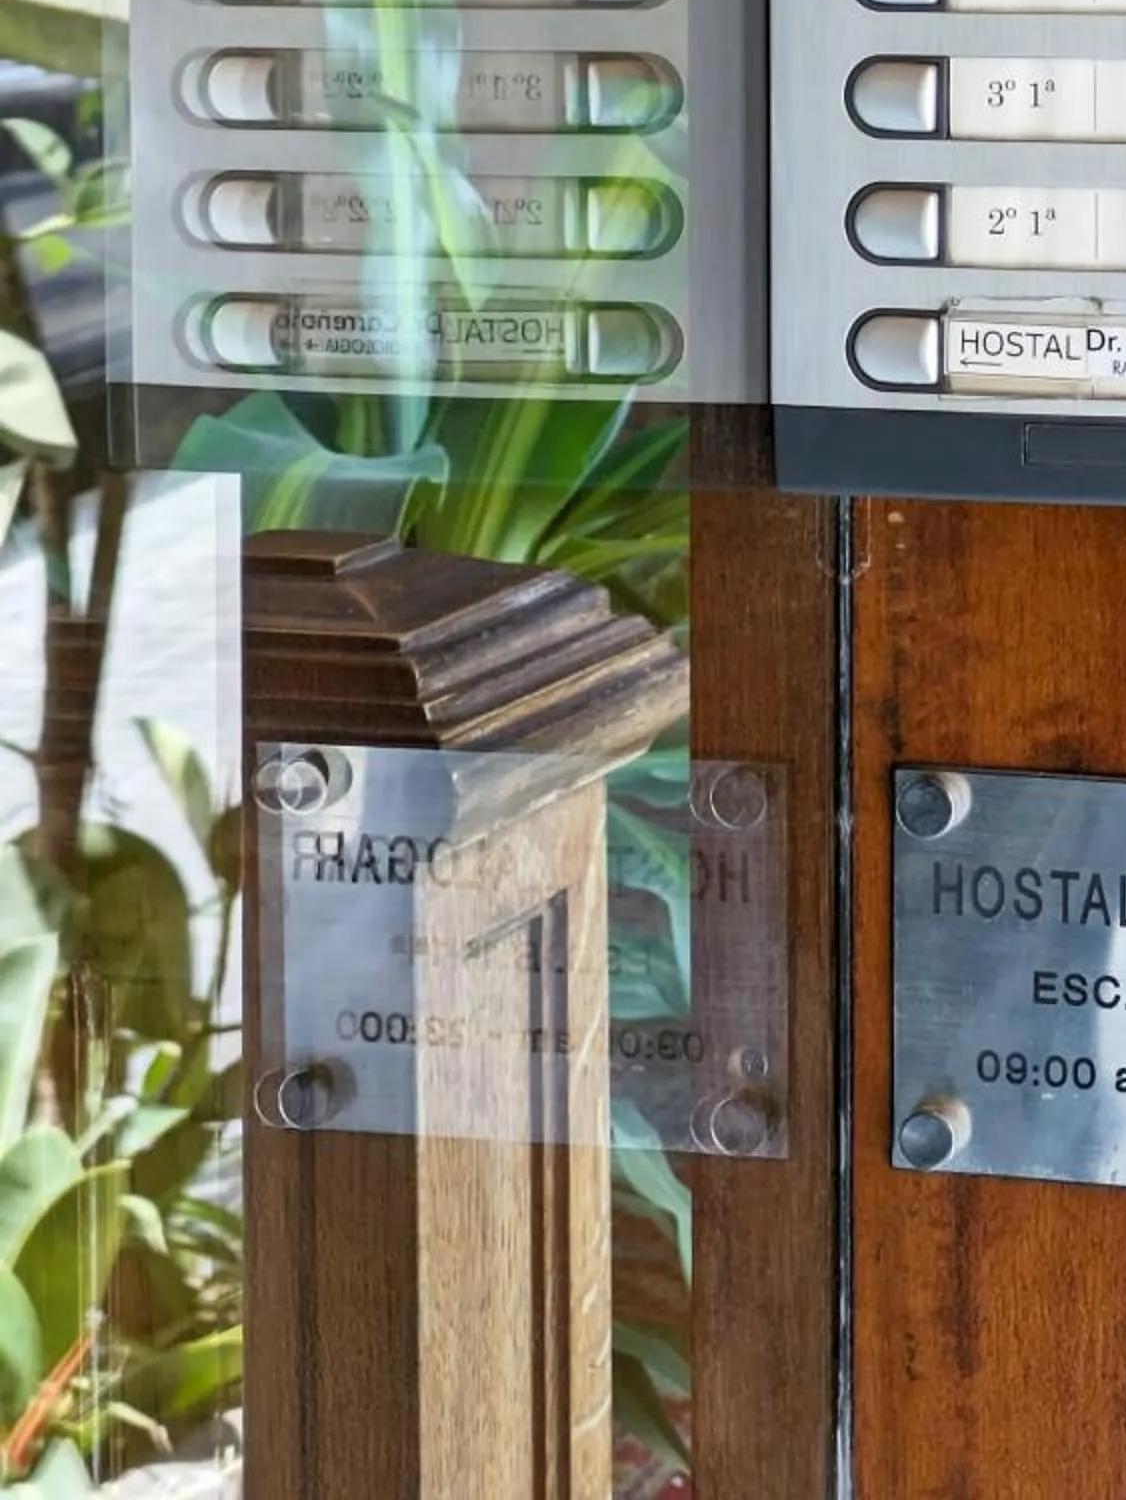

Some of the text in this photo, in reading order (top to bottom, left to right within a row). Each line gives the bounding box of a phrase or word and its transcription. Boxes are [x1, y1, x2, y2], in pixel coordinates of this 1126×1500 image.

[959, 329, 1082, 361] HOSTAL
[1085, 328, 1122, 353] Dr.
[976, 1049, 1097, 1090] 09:00
